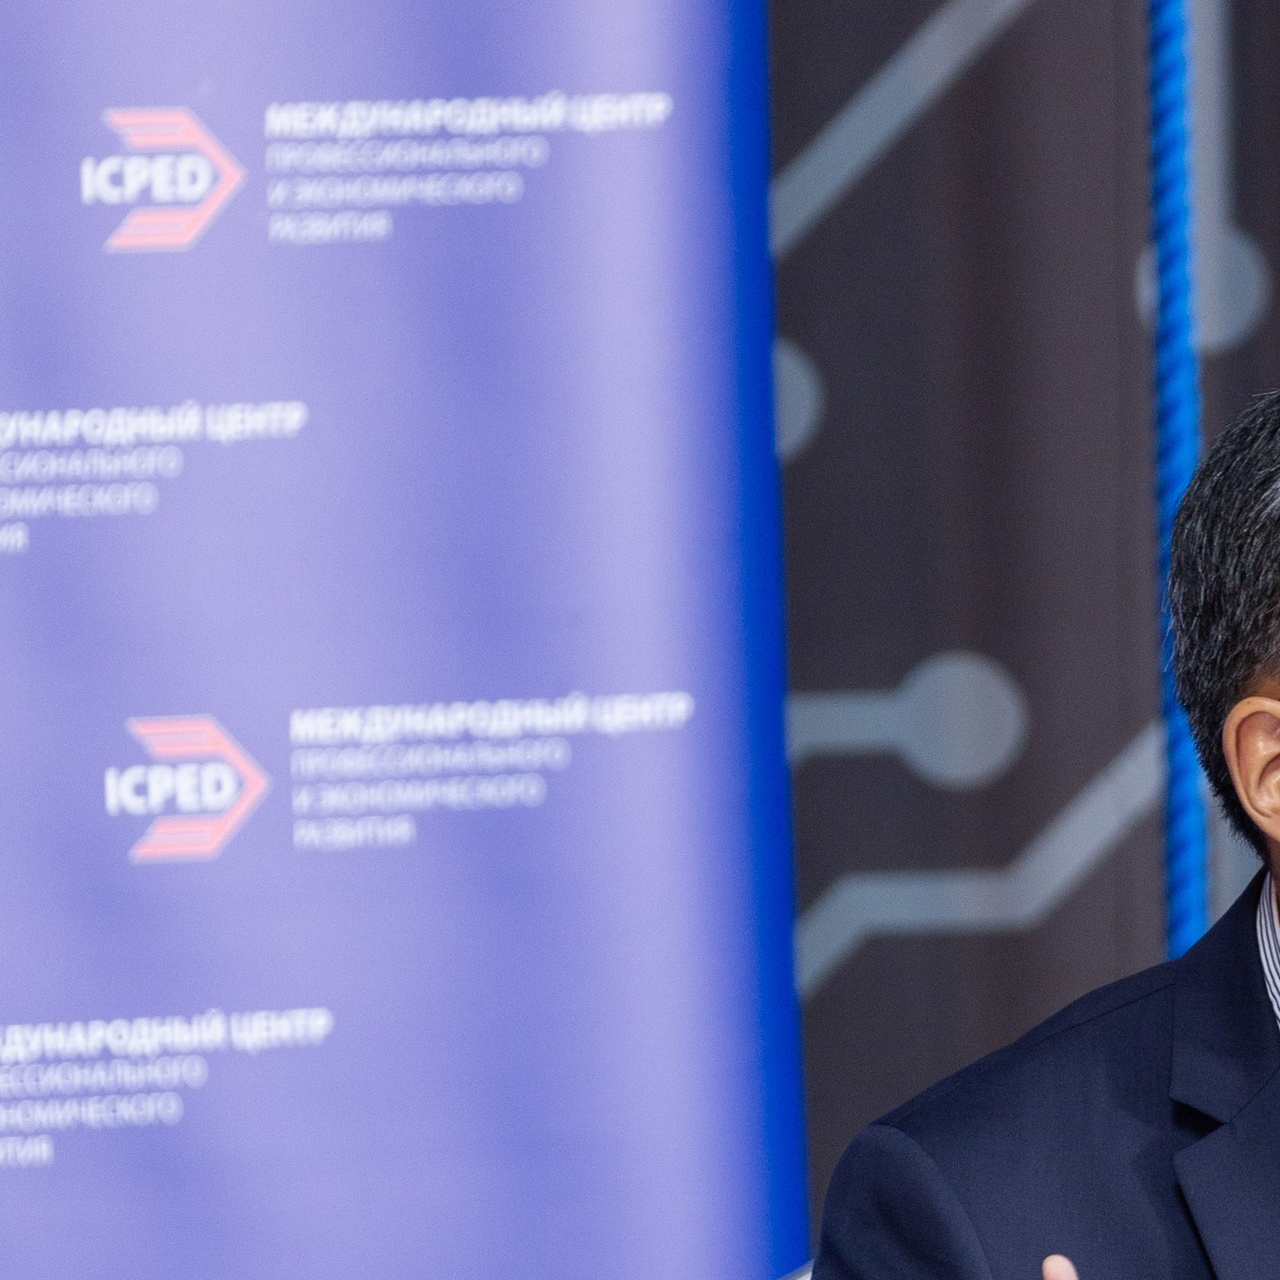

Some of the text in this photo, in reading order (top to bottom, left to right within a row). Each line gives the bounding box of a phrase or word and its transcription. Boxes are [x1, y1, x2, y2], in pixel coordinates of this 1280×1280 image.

[265, 91, 671, 137] МЕЖДУНАРОДНЫЙ ЦЕНТР
[81, 154, 213, 203] ICPED
[205, 401, 307, 446] ЦЕНТР
[290, 691, 693, 745] МЕЖДУНАРОДНЫЙ ЦЕНТР
[105, 761, 238, 816] ICPED
[230, 1007, 332, 1053] ЦЕНТР
